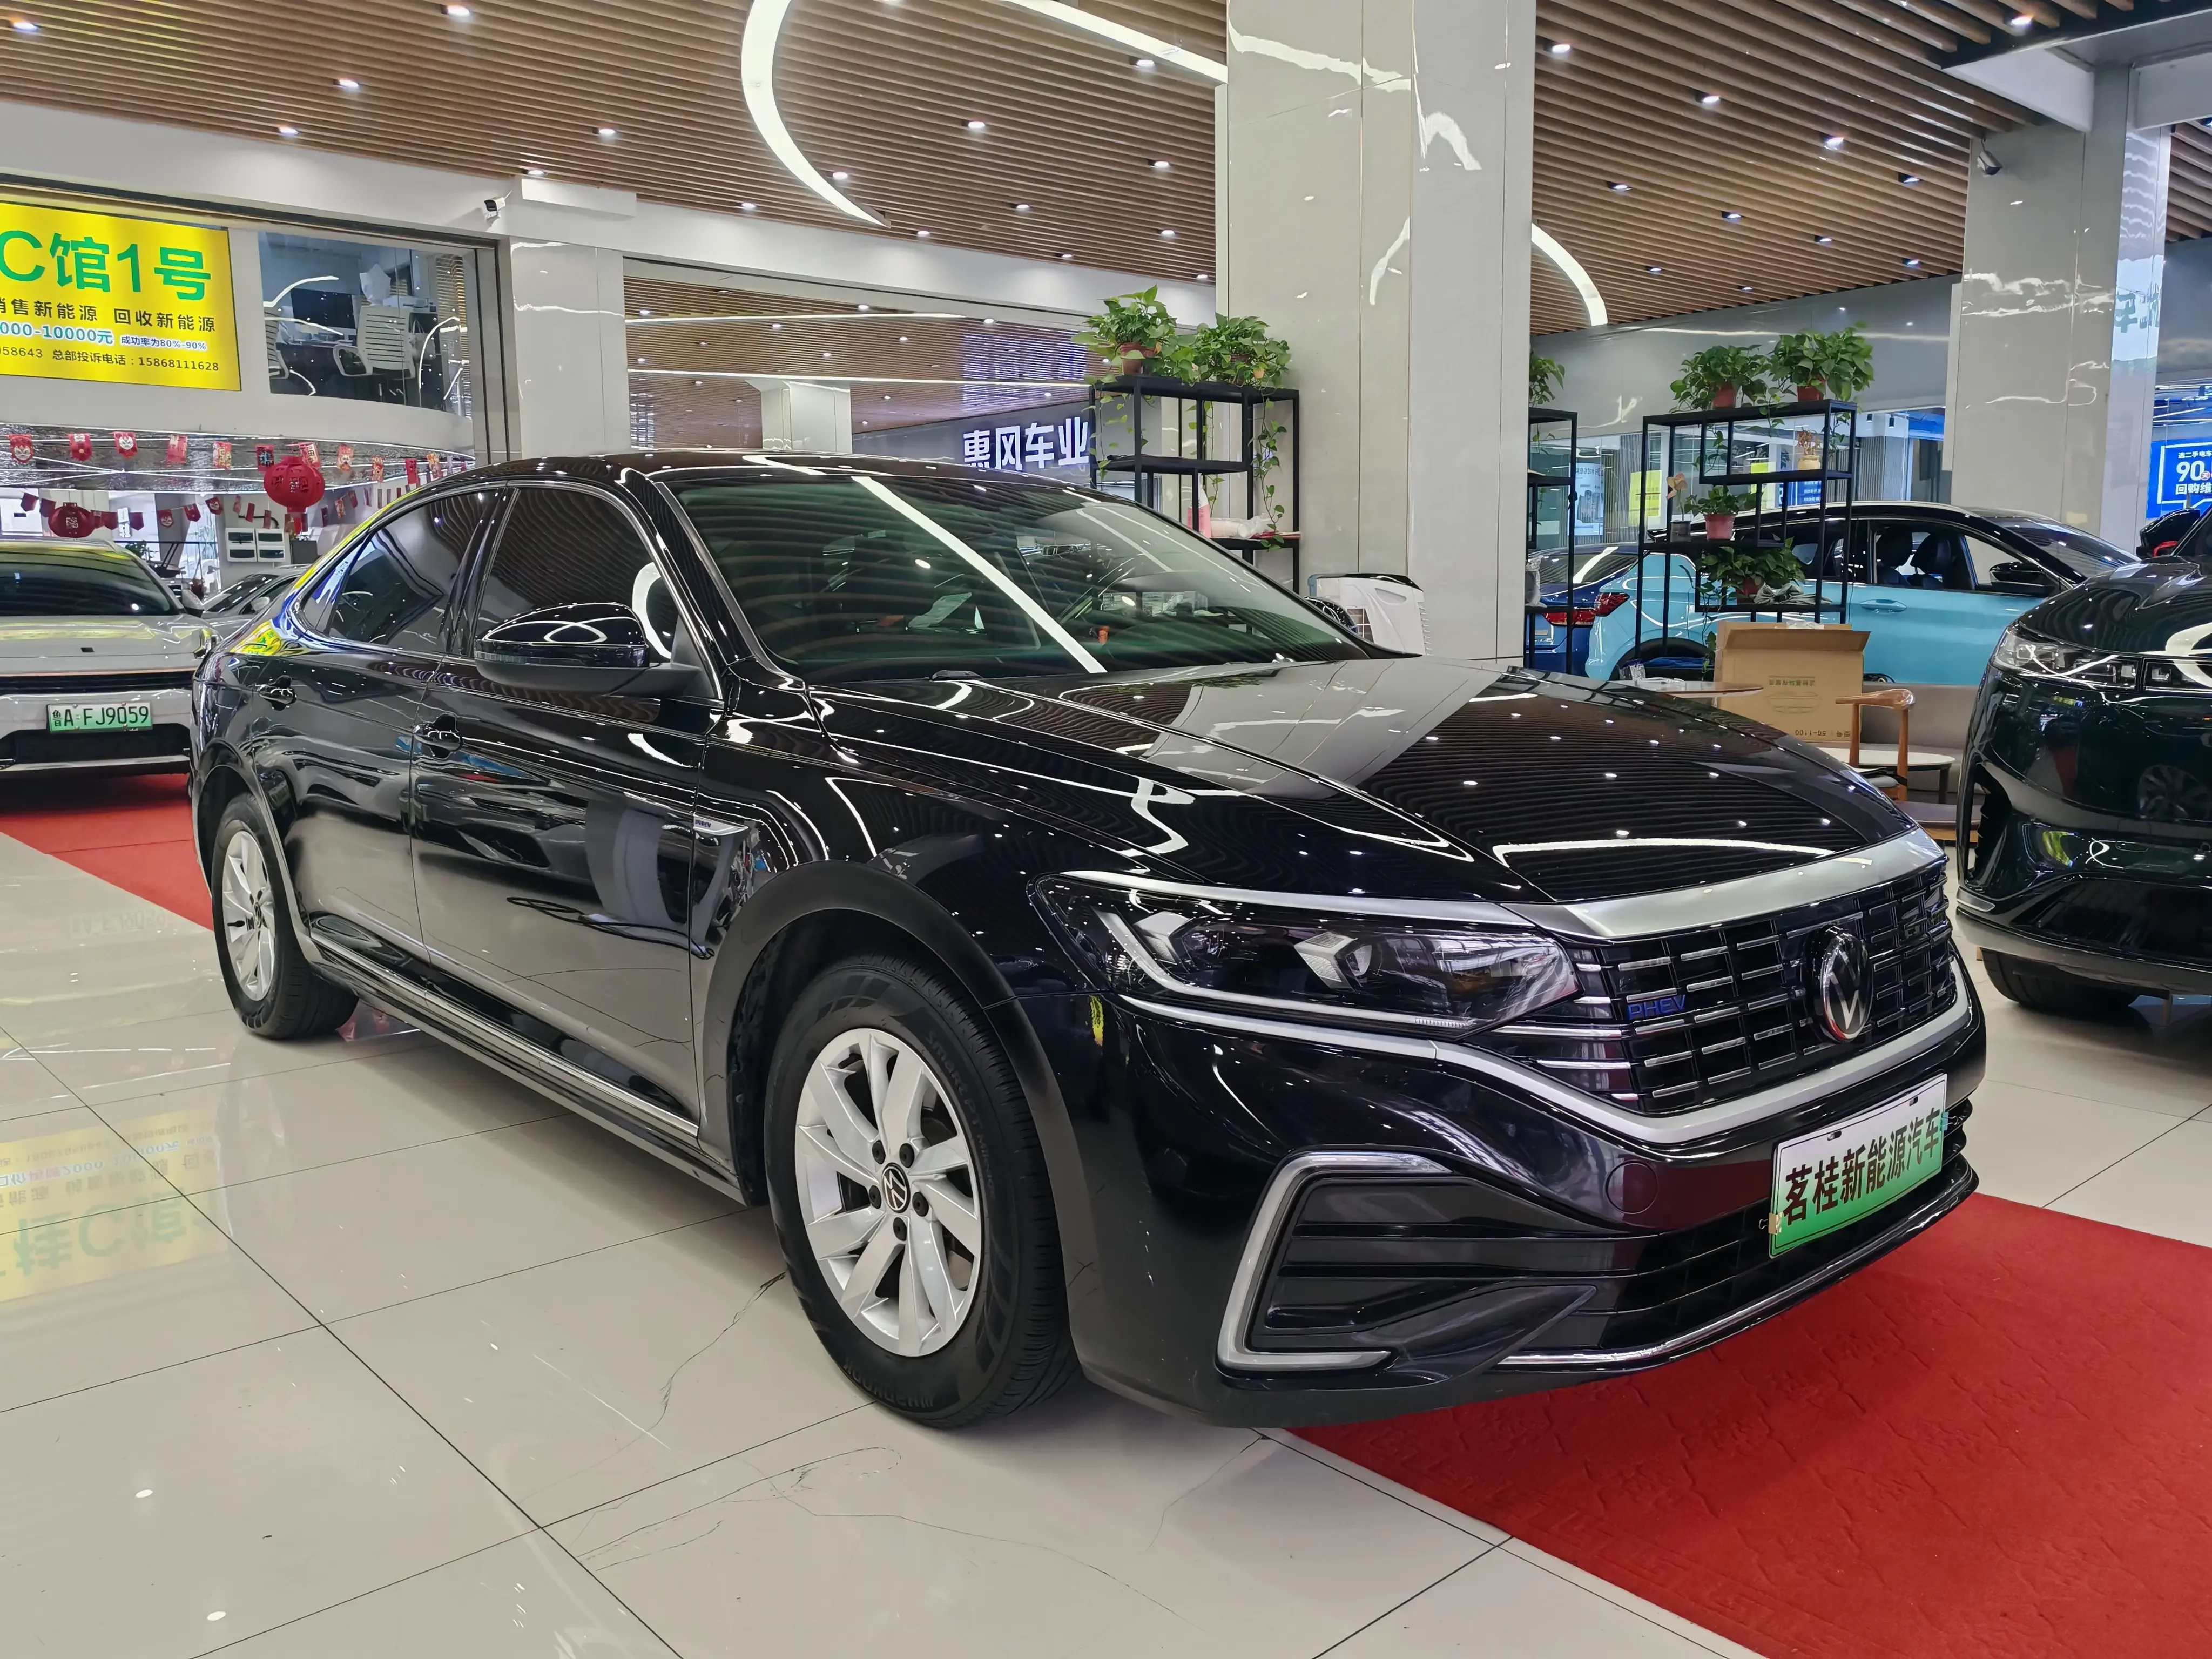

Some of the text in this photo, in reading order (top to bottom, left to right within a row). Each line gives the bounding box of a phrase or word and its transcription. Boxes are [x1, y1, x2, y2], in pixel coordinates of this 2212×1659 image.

[0, 230, 211, 300] C馆1号
[114, 308, 215, 332] 回收新能源
[0, 346, 43, 358] 58643
[122, 336, 206, 350] 成功率为80%-90%
[963, 417, 1089, 470] 惠风车业
[1628, 994, 1685, 1020] PHEV
[1782, 1107, 1941, 1226] 茗桂新能源汽车
